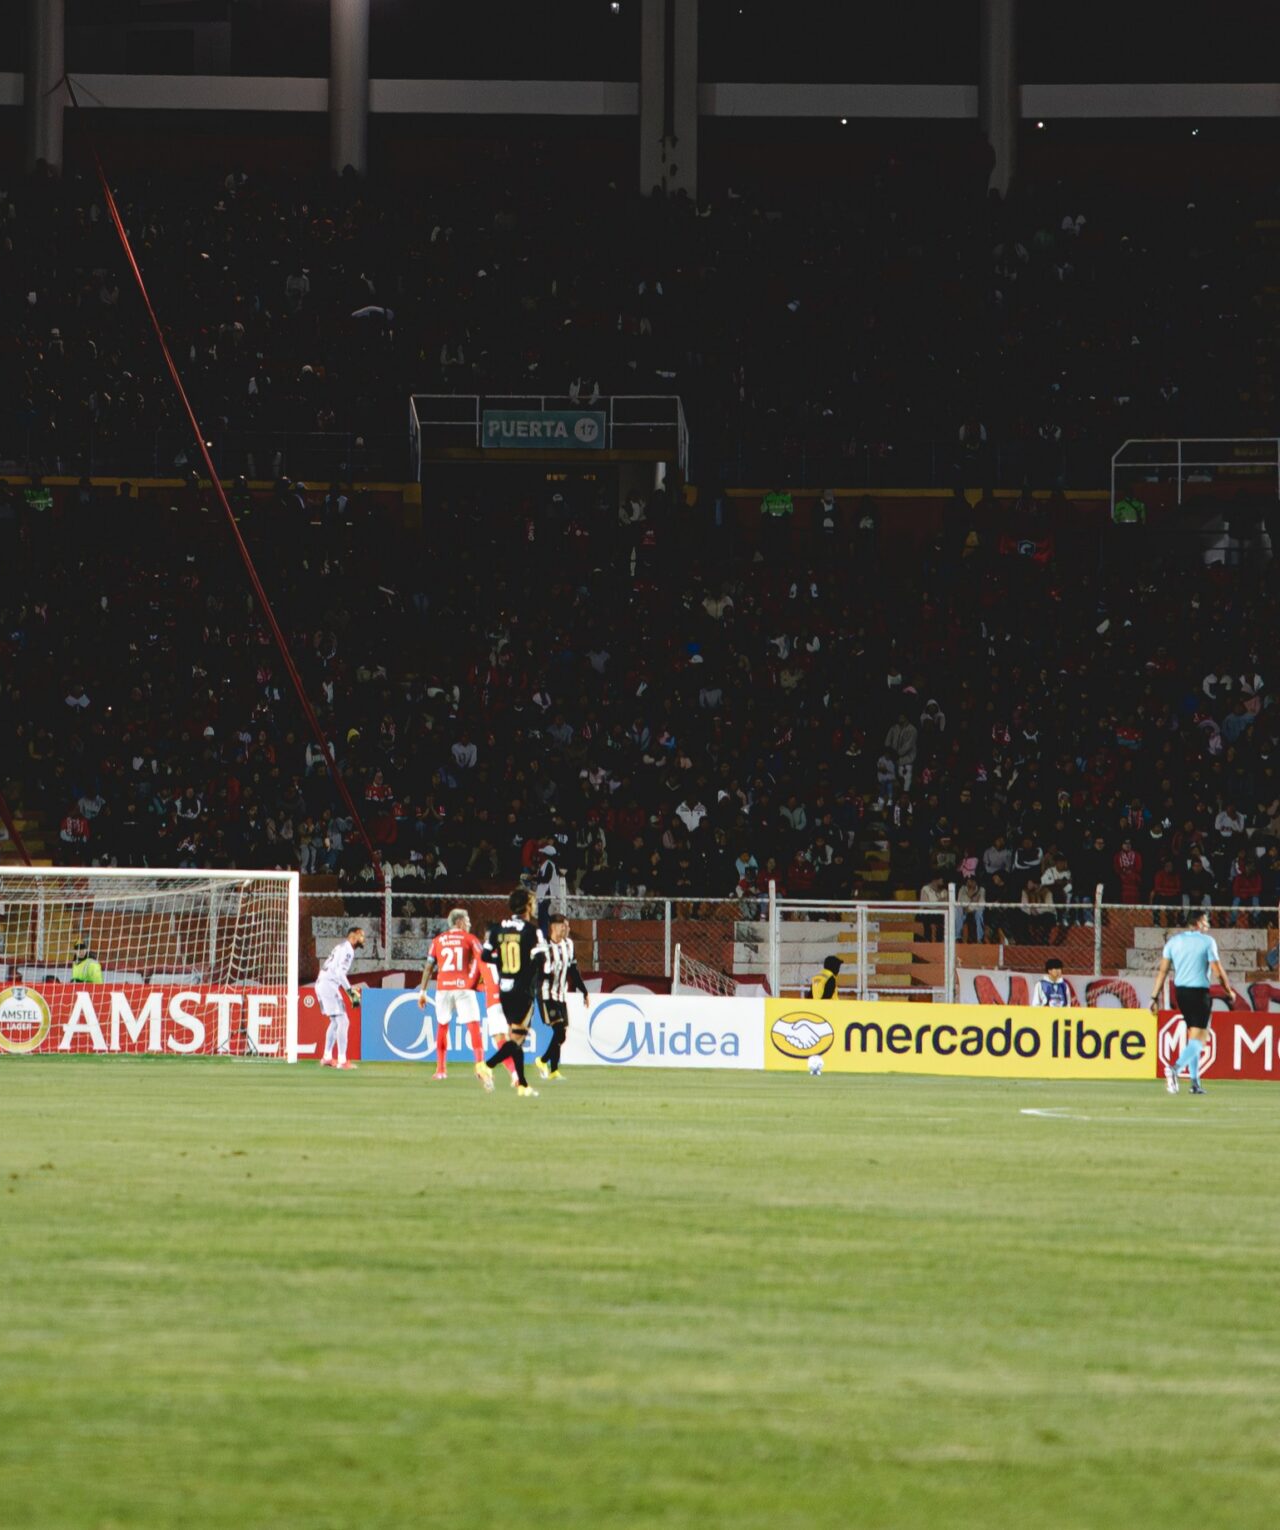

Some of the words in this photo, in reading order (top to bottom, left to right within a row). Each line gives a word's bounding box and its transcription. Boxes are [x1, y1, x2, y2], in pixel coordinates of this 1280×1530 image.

[487, 420, 569, 438] PUERTA
[440, 947, 463, 972] 21
[500, 940, 521, 975] 10
[1, 1010, 38, 1020] AMSTEL
[613, 1021, 740, 1056] Midea
[844, 1017, 1041, 1057] mercado
[1051, 1019, 1147, 1060] libre
[1233, 1024, 1280, 1071] M
